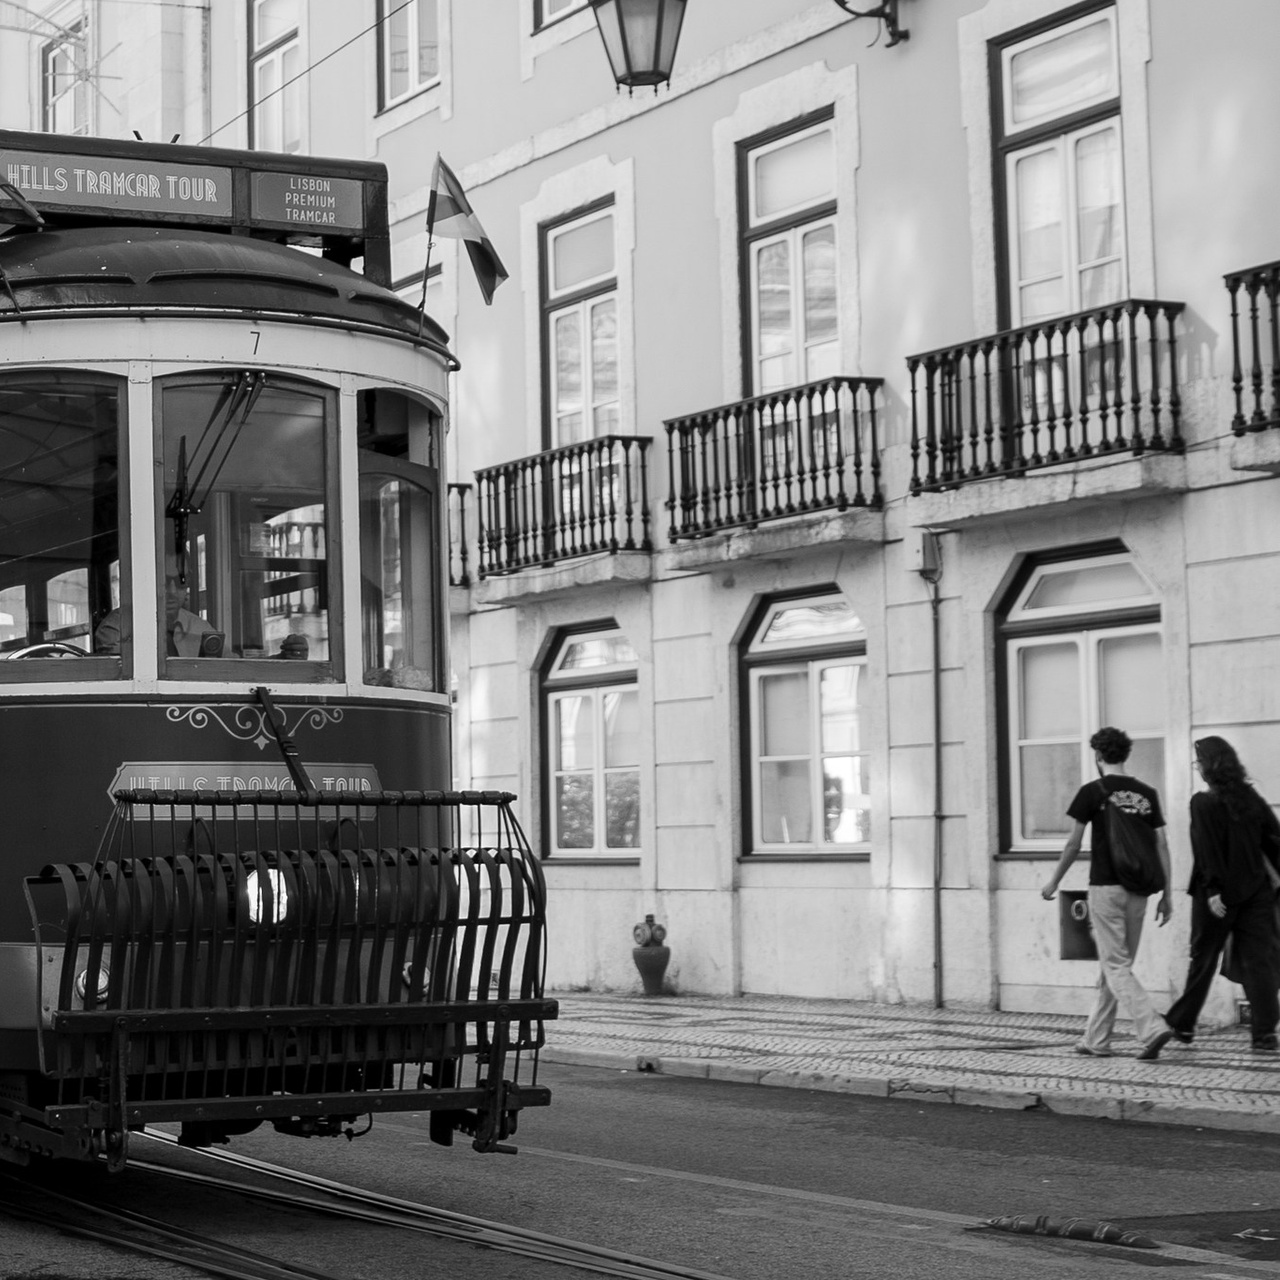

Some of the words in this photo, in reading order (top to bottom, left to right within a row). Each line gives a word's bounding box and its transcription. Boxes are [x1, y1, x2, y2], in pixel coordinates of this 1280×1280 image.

[7, 163, 68, 192] HILLS
[73, 168, 161, 198] TRAMCAR
[166, 175, 217, 202] TOUR
[290, 177, 330, 192] LISBON
[285, 192, 335, 208] PREMIUM
[285, 208, 335, 224] TRAMCAR
[250, 330, 260, 355] 7
